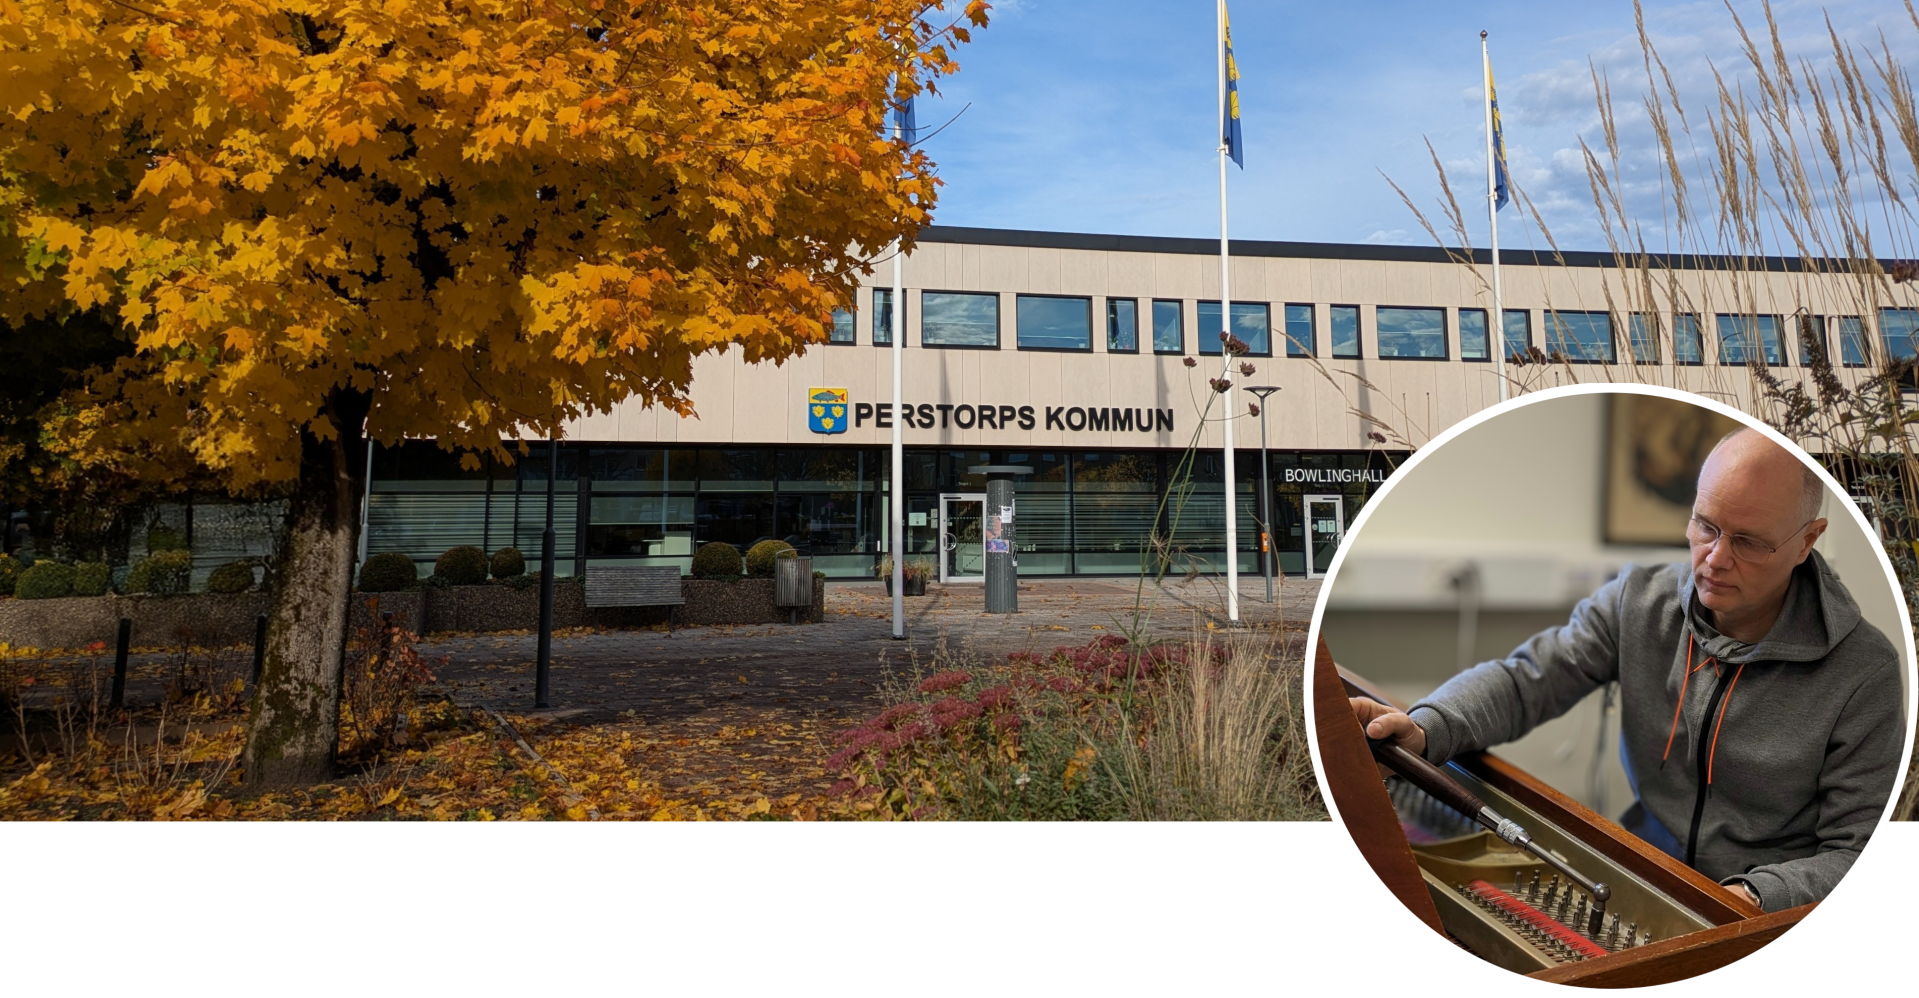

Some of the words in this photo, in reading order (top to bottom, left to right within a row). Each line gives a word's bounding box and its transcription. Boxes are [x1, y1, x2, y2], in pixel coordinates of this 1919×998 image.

[855, 402, 1036, 430] PERSTORPS
[1045, 406, 1174, 432] KOMMUN
[1285, 468, 1386, 482] BOWLINGHALL
